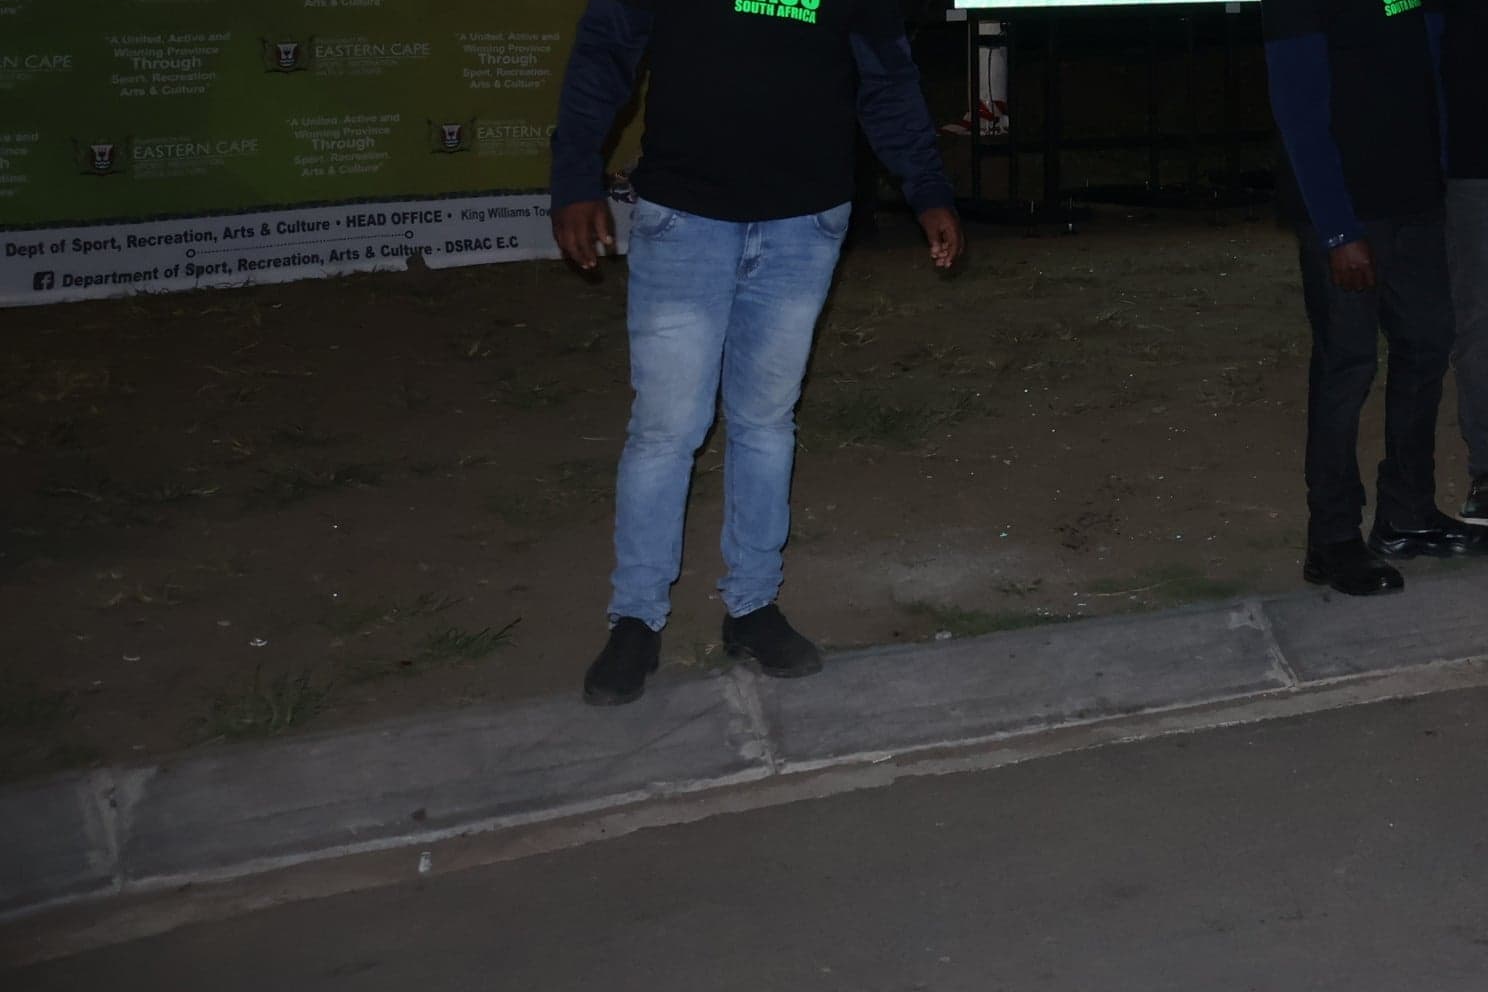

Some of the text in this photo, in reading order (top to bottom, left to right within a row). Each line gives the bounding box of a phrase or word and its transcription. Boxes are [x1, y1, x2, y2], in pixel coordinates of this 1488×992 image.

[304, 0, 327, 8] Arts
[734, 0, 816, 24] SOUTH AFRICA
[207, 31, 230, 41] and
[542, 32, 560, 41] and
[167, 47, 219, 57] Province
[315, 42, 431, 58] EASTERN CAPE
[508, 43, 551, 53] Province
[24, 54, 72, 69] CAPE
[132, 56, 201, 72] Through
[479, 53, 537, 67] Through
[470, 80, 491, 89] Arts
[119, 86, 145, 96] Arts
[343, 126, 391, 137] Province
[478, 126, 541, 138] EASTERN
[133, 139, 259, 159] EASTERN CAPE
[311, 137, 376, 152] Through
[301, 167, 324, 176] Arts
[5, 240, 45, 258] Dept
[49, 238, 66, 253] of
[71, 236, 122, 255] Sport,
[126, 228, 219, 249] Recreation,
[222, 226, 255, 241] Arts
[260, 222, 271, 237] &
[276, 218, 331, 235] Culture
[346, 211, 387, 228] HEAD
[391, 210, 443, 225] OFFICE
[461, 208, 486, 223] King
[488, 207, 531, 219] Williams
[62, 268, 158, 288] Department
[163, 263, 180, 279] of
[185, 261, 232, 278] Sport,
[238, 251, 324, 272] Recreation,
[329, 248, 360, 262] Arts
[364, 245, 376, 259] &
[380, 242, 432, 257] Culture
[445, 237, 493, 254] DSRAC
[496, 235, 519, 249] E.C
